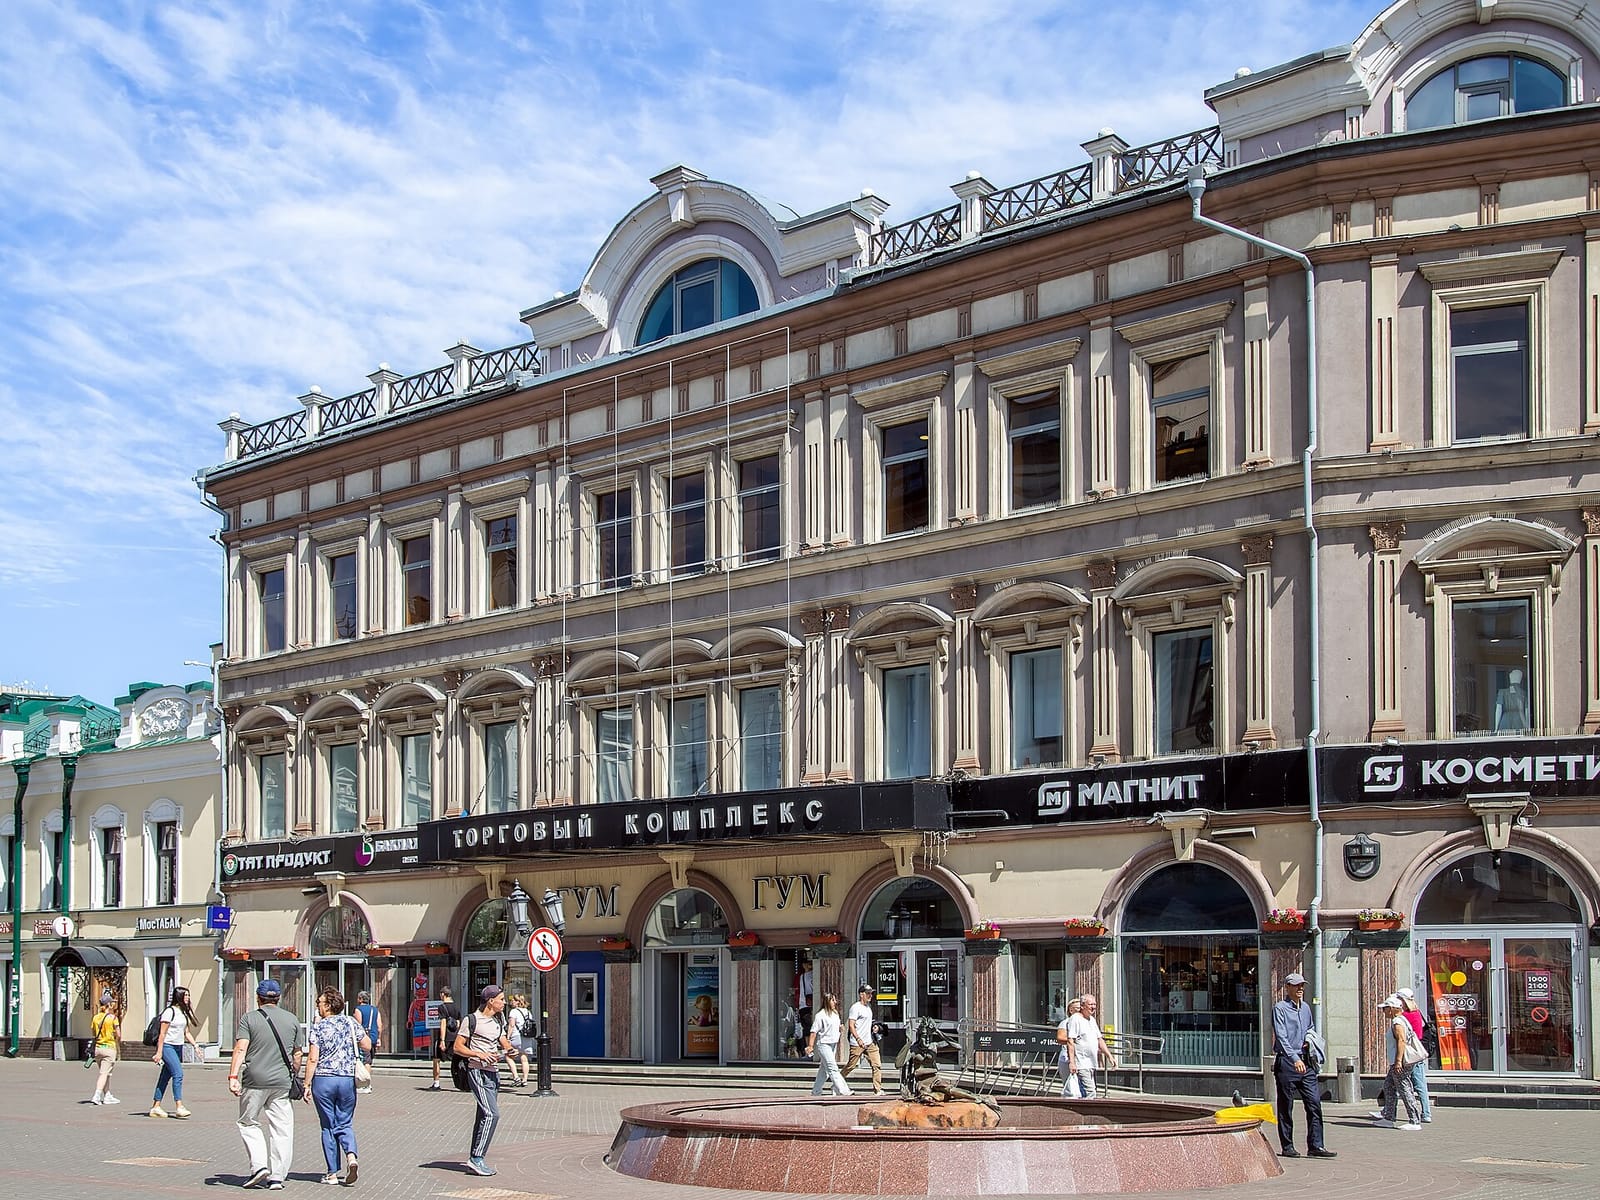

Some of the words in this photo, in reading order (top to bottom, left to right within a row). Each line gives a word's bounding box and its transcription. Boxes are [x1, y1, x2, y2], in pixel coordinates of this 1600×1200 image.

[1078, 774, 1205, 807] МАГНИТ
[452, 813, 593, 849] ТОРГОВЫЙ
[625, 799, 824, 835] КОМПЛЕКС
[237, 855, 264, 871] ТАТ
[265, 849, 332, 869] ПРОДУКТ
[752, 873, 829, 911] ГУМ
[140, 917, 182, 931] МосТАБАК
[879, 972, 896, 982] 10-21
[929, 972, 947, 982] 10-21
